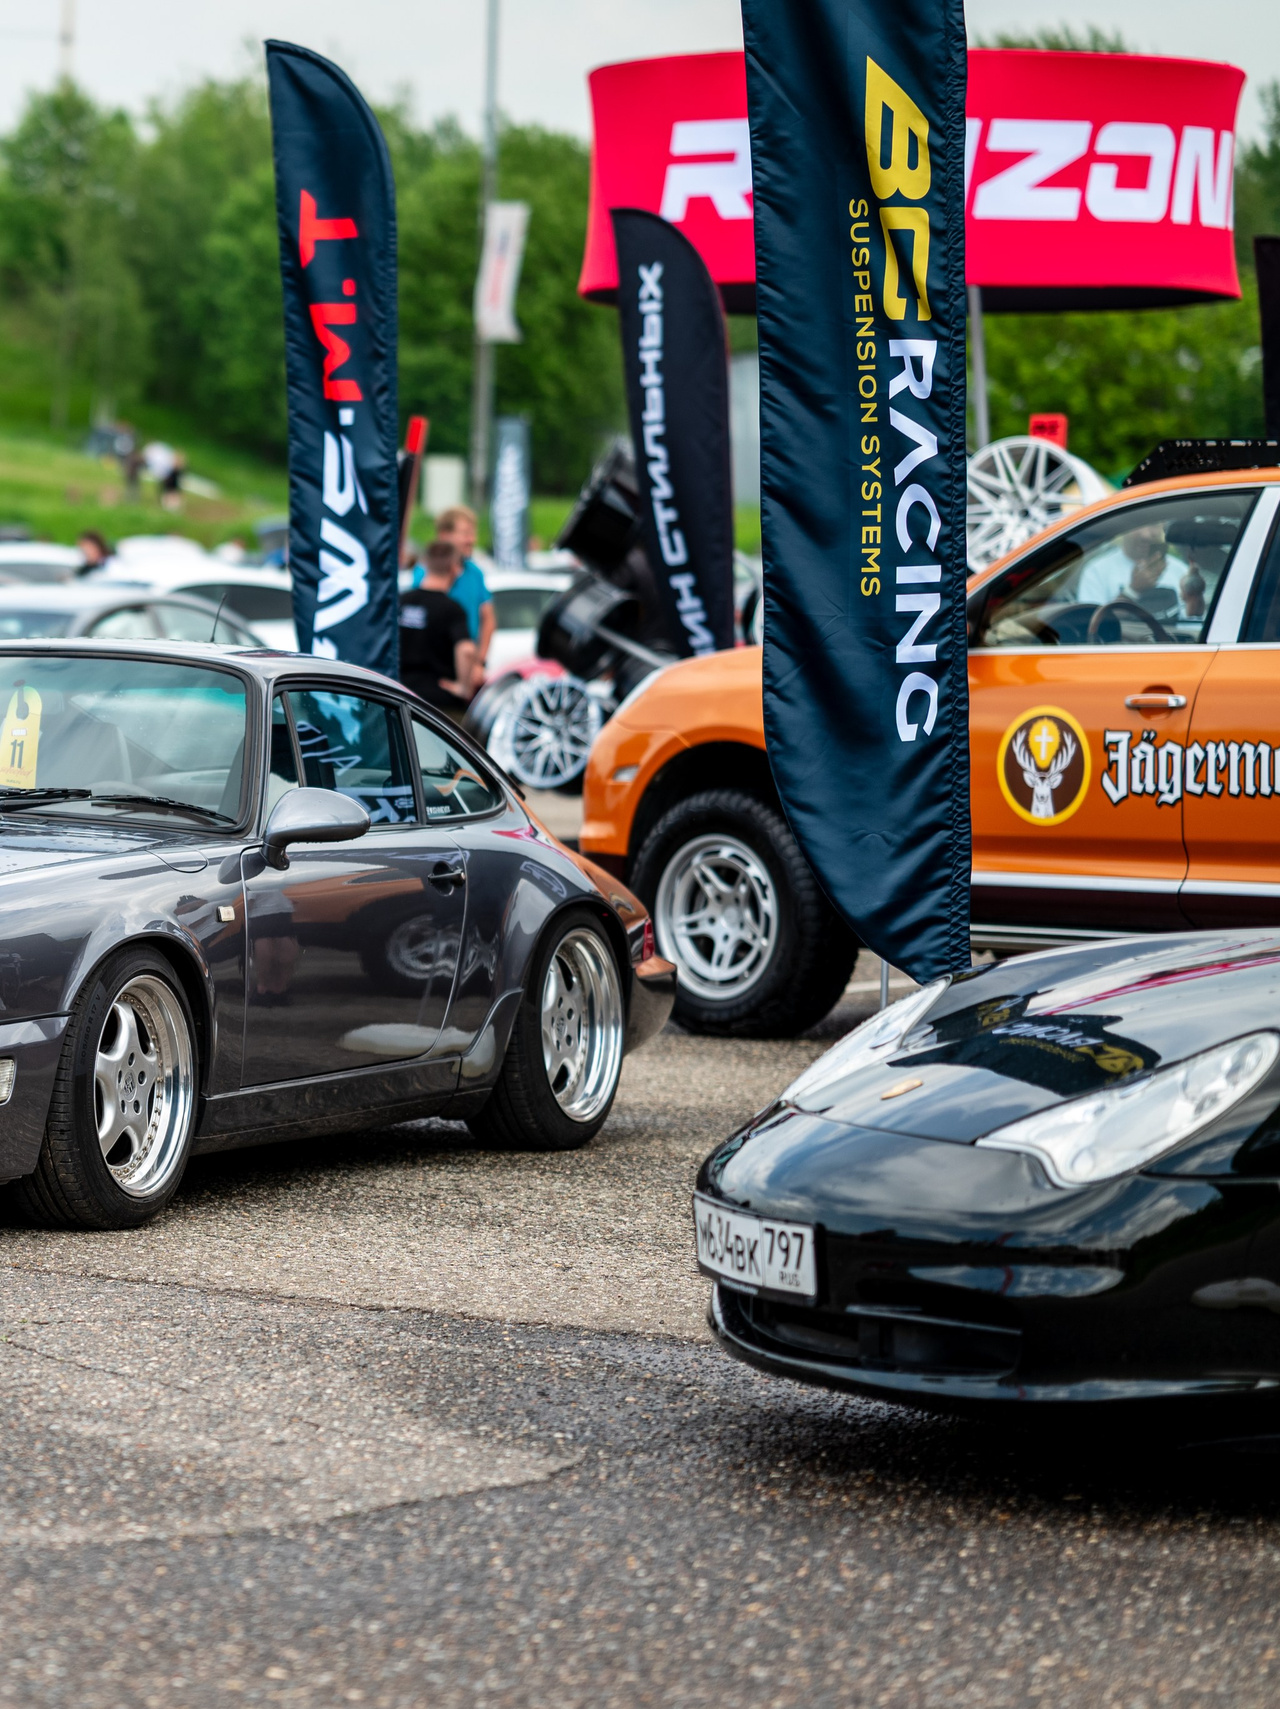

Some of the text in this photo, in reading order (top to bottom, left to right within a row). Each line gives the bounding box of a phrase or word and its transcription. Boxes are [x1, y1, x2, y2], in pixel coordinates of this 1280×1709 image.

[637, 261, 686, 567] СТИЛЬНЫХ
[848, 198, 882, 597] SUSPENSION SYSTEMS
[865, 55, 942, 742] BC RACING
[10, 739, 24, 769] 11
[764, 1227, 804, 1270] 797
